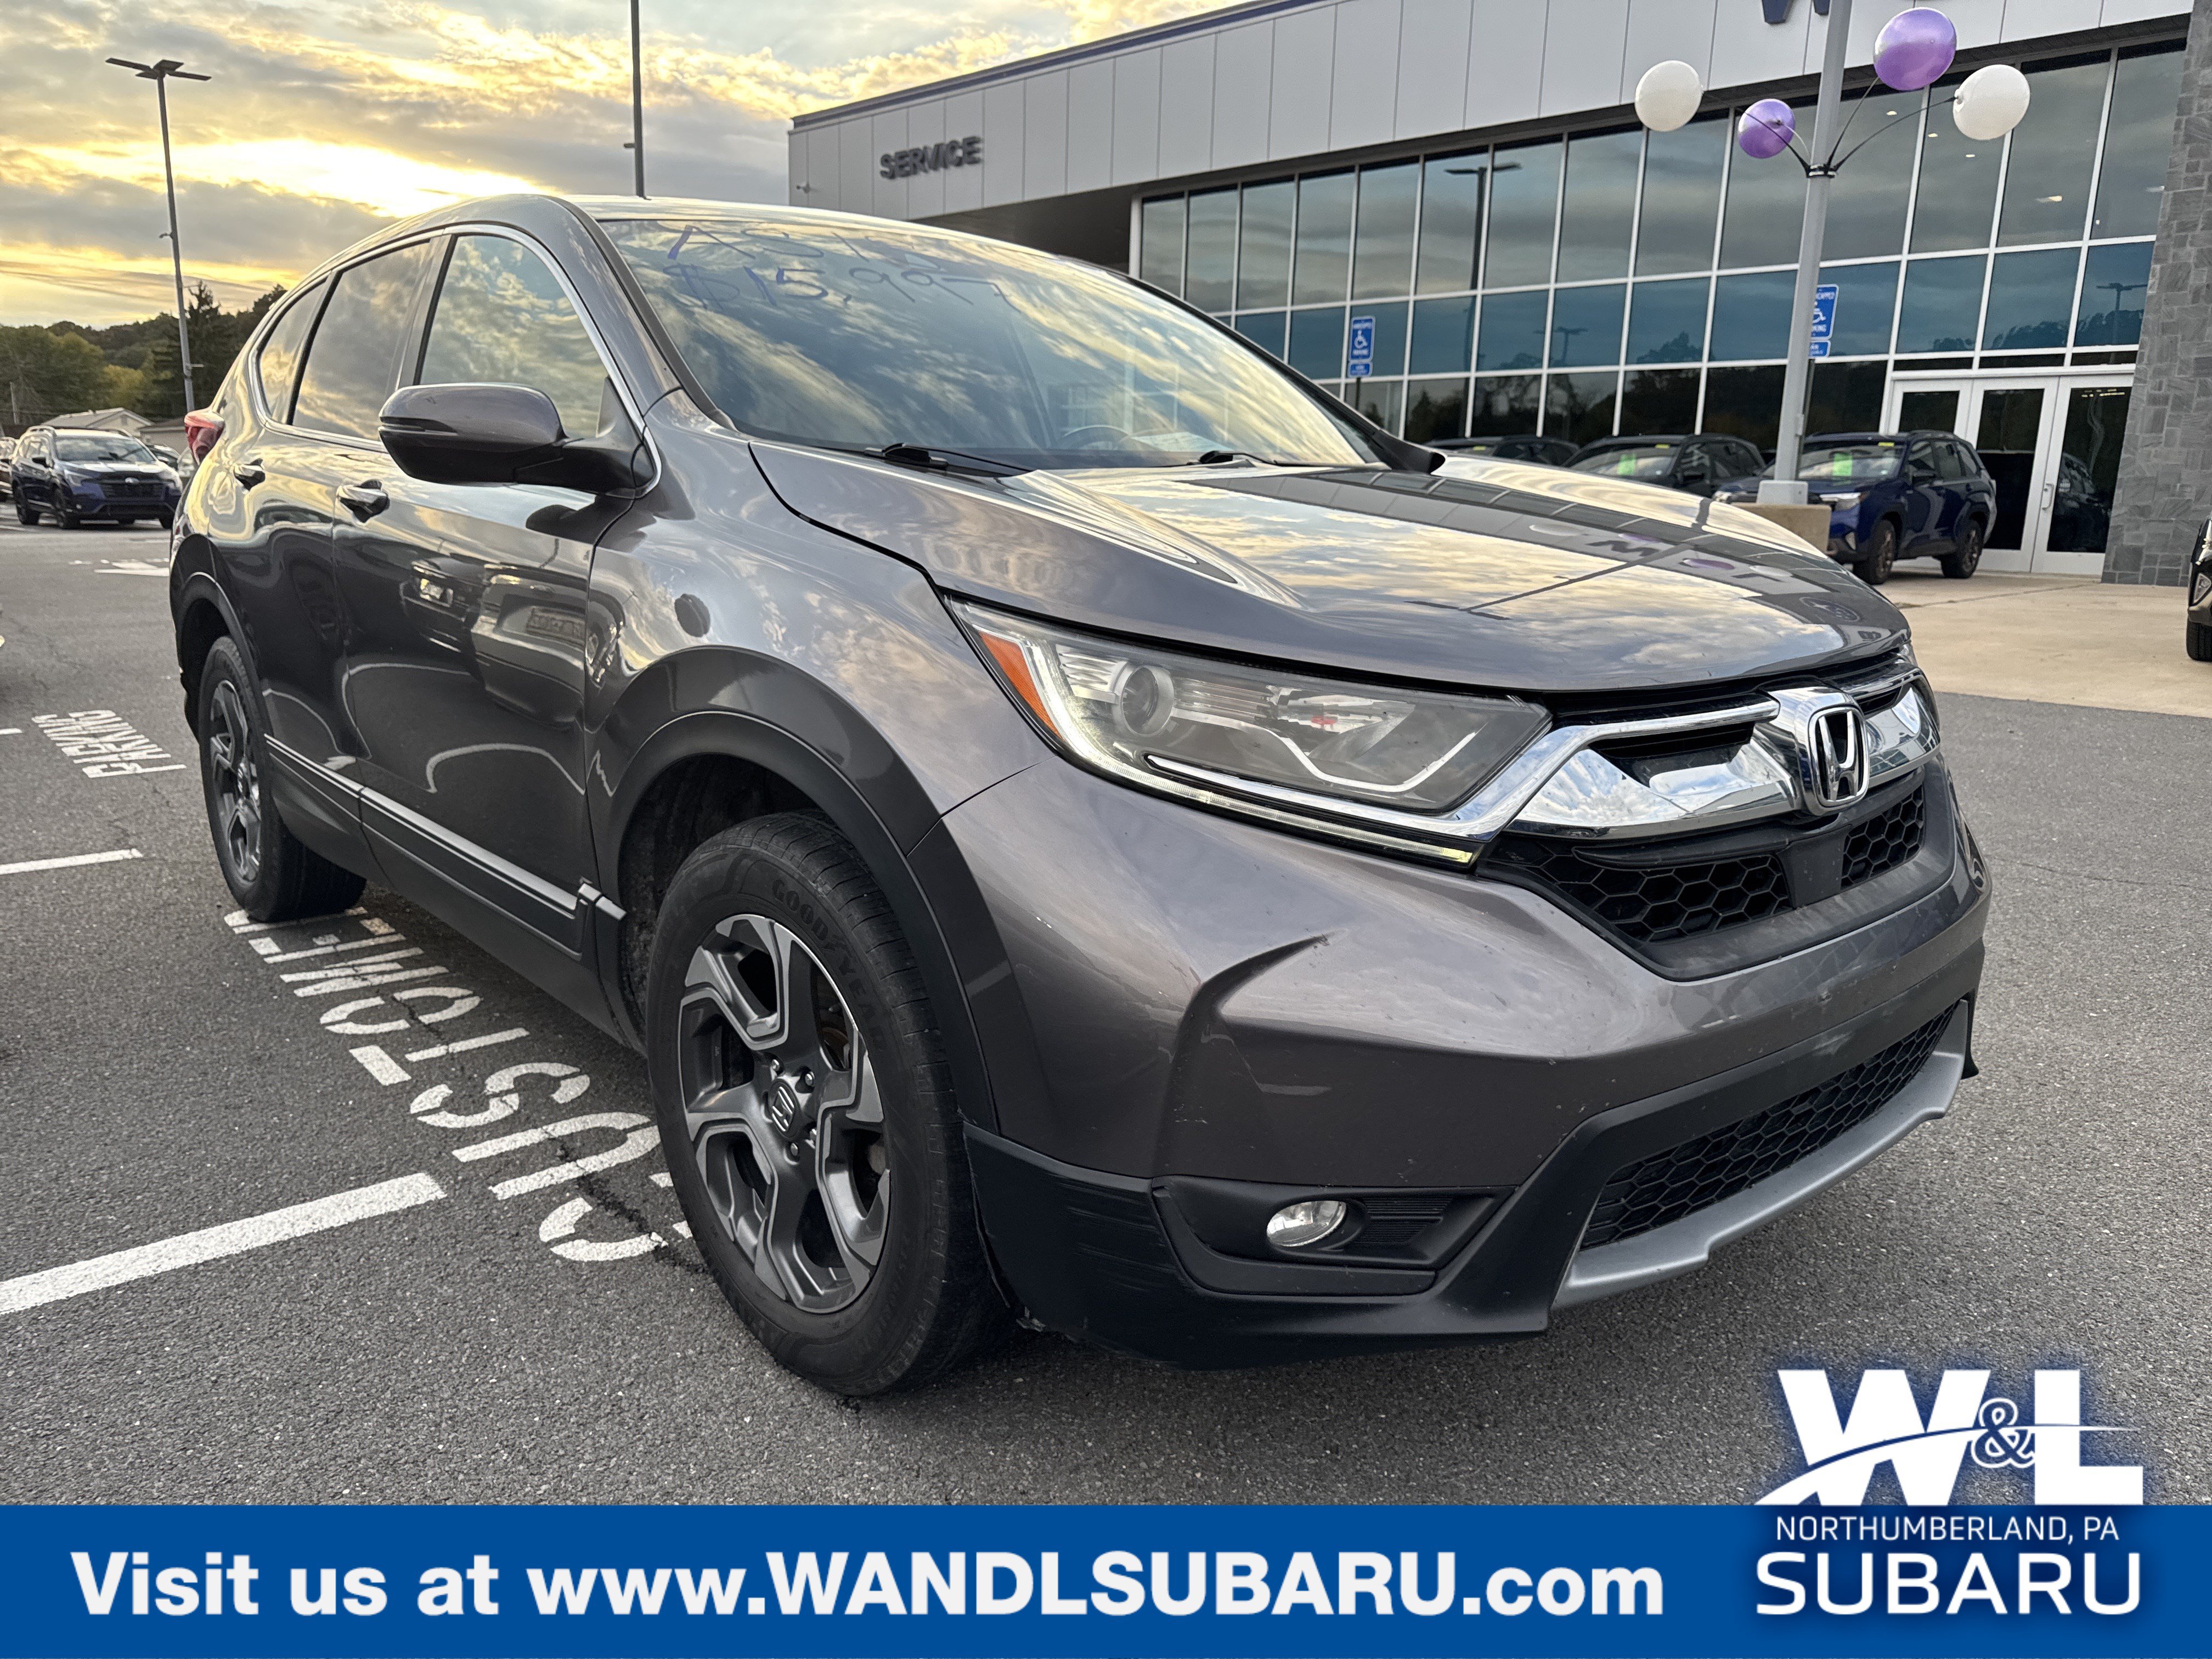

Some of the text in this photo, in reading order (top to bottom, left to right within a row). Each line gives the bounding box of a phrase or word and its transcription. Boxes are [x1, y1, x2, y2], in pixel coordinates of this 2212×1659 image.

[880, 136, 983, 180] SERVICE
[663, 264, 1023, 313] $15,997
[31, 709, 187, 778] PARKING
